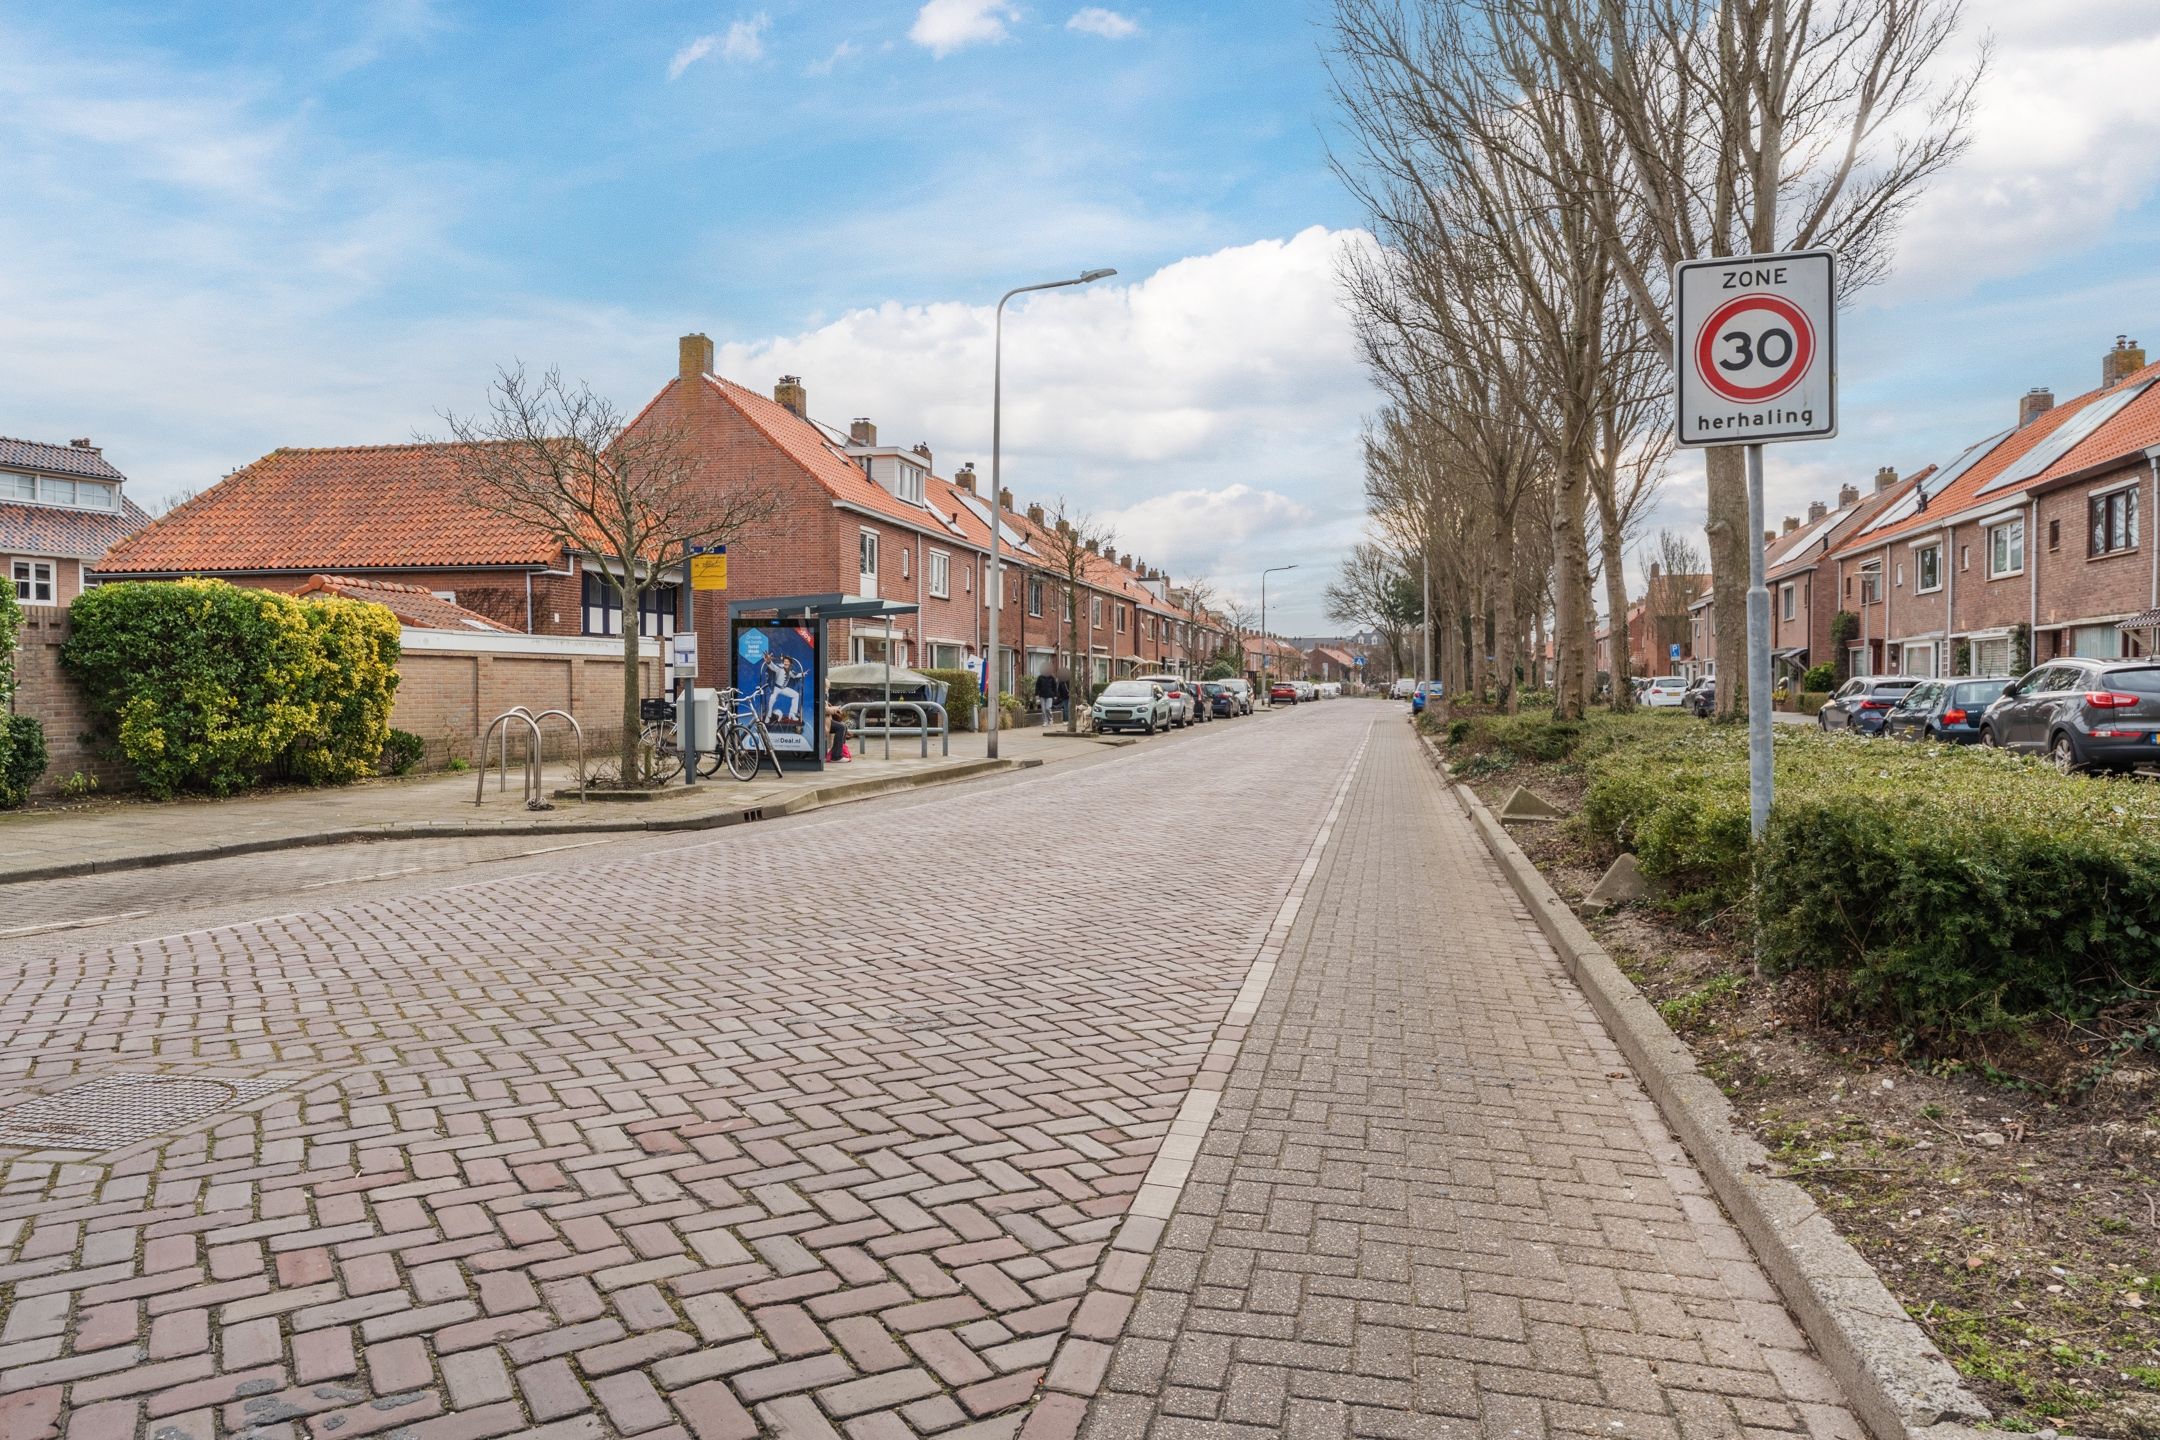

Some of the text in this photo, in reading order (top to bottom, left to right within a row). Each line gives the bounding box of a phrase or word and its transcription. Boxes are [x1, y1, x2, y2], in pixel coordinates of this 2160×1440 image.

[1722, 267, 1788, 289] ZONE
[1719, 328, 1793, 371] 30
[1698, 409, 1814, 431] herhaling
